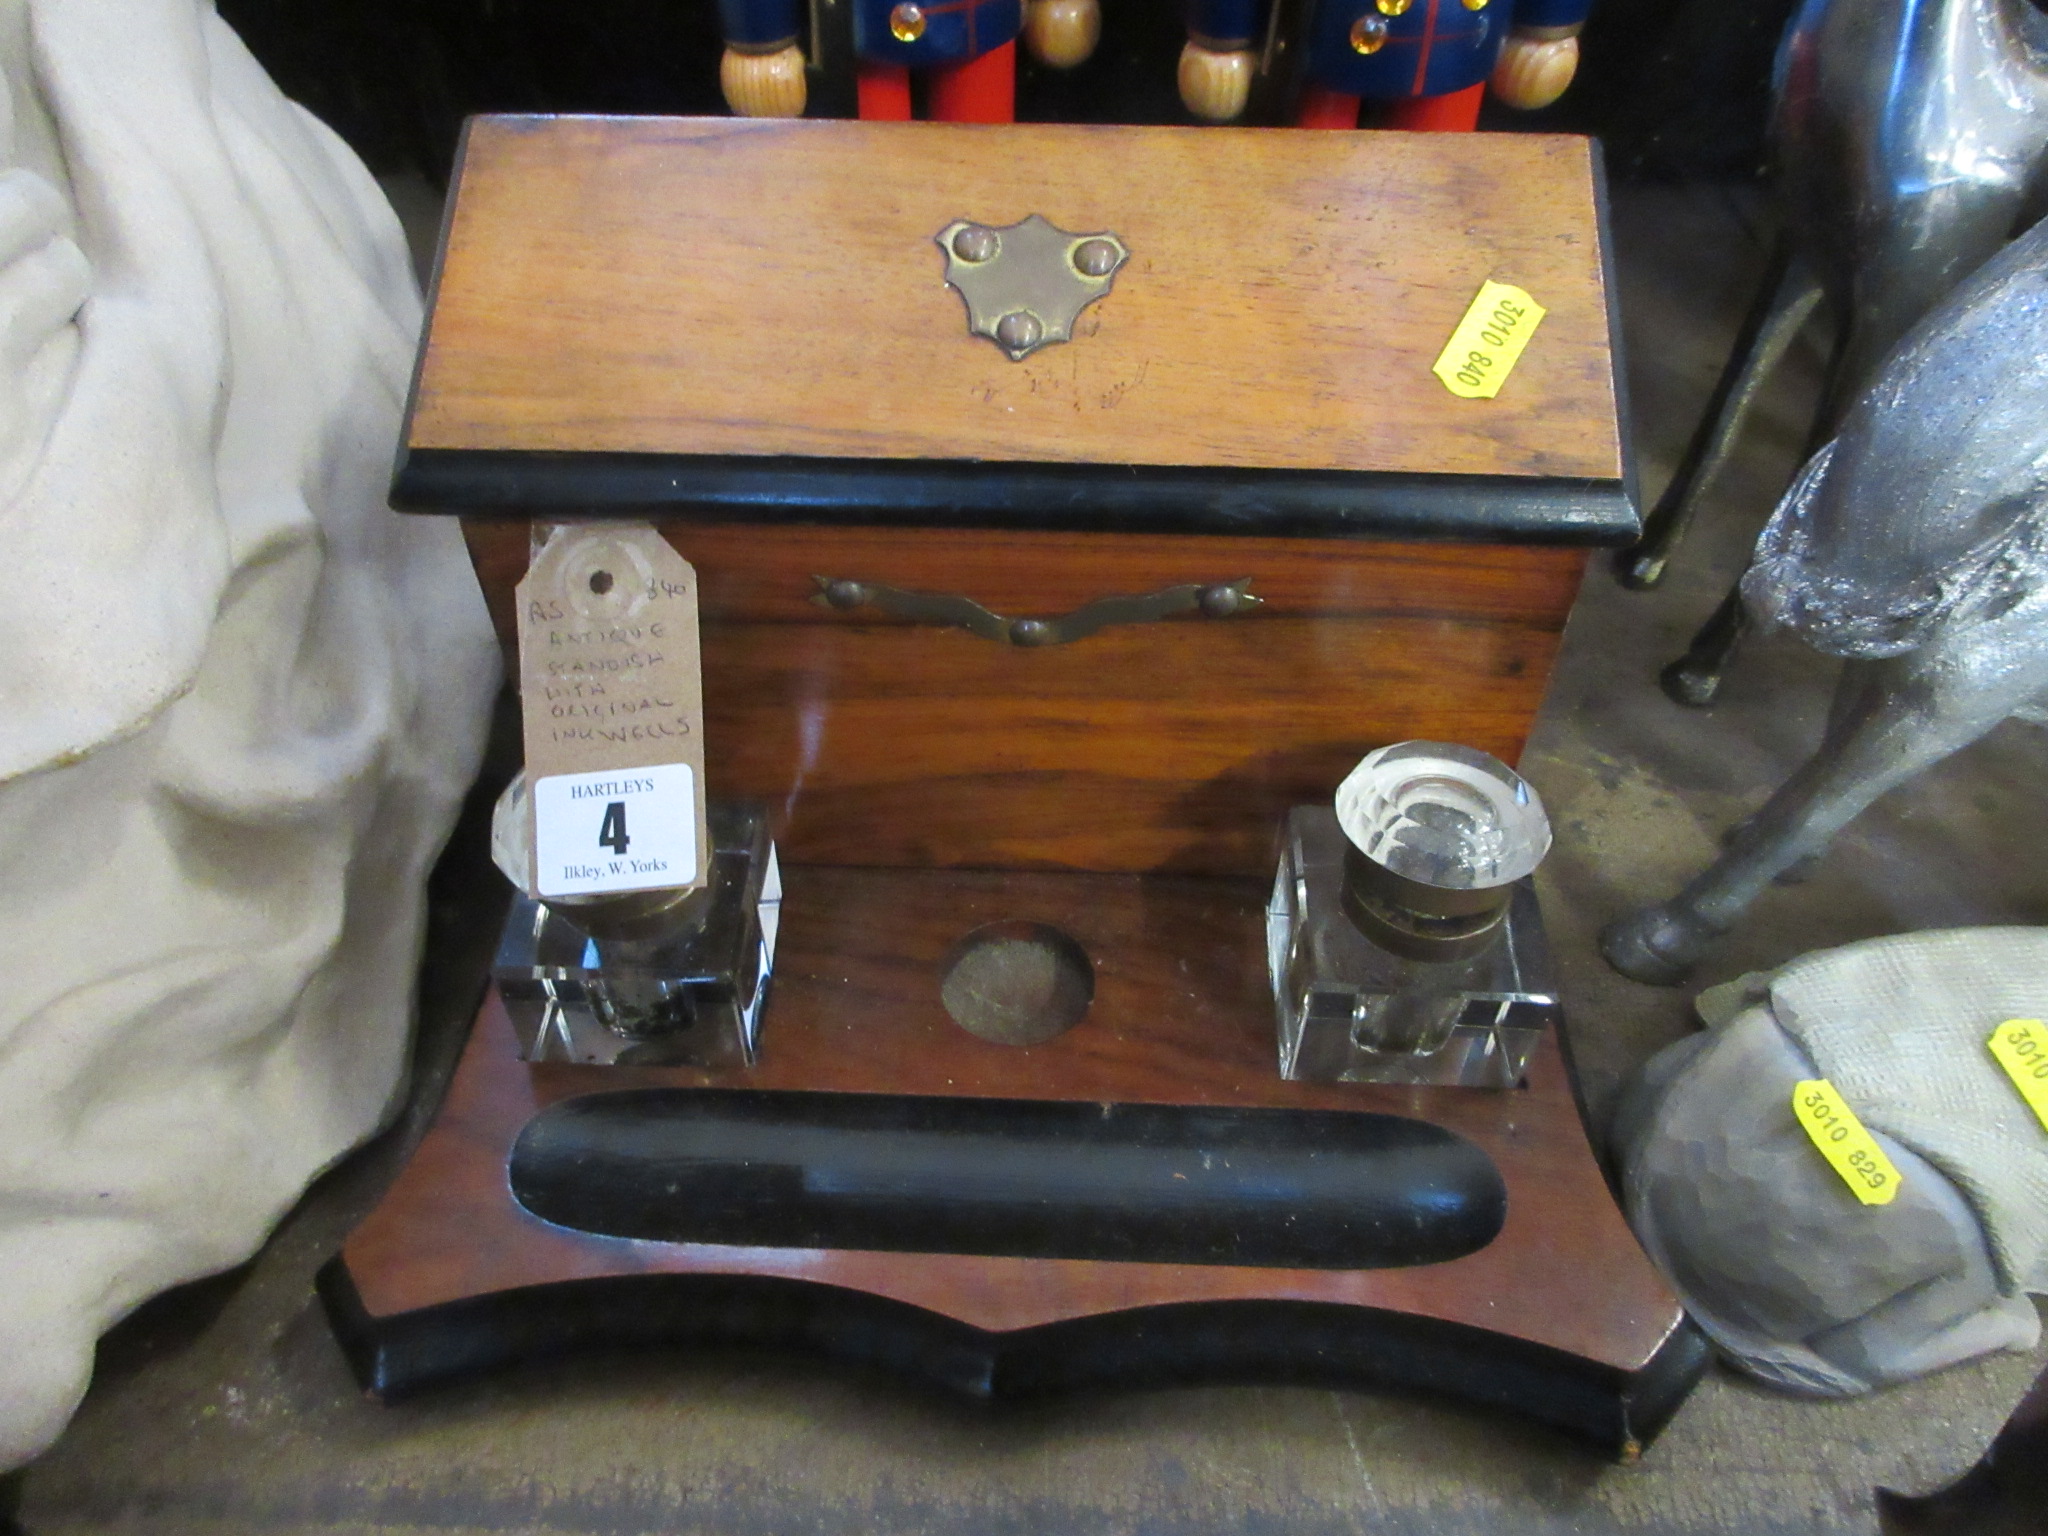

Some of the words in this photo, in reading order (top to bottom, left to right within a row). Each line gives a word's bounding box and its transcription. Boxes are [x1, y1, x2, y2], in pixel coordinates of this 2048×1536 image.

[1480, 299, 1526, 347] 3010
[1456, 350, 1493, 387] 840
[571, 778, 654, 799] HARTLEYS
[599, 801, 630, 855] 4
[564, 864, 605, 881] Ilkley,
[608, 861, 626, 876] W.
[630, 858, 668, 873] Yorks
[2007, 1027, 2048, 1079] 3010
[1804, 1091, 1849, 1142] 3010
[1848, 1149, 1887, 1189] 829
